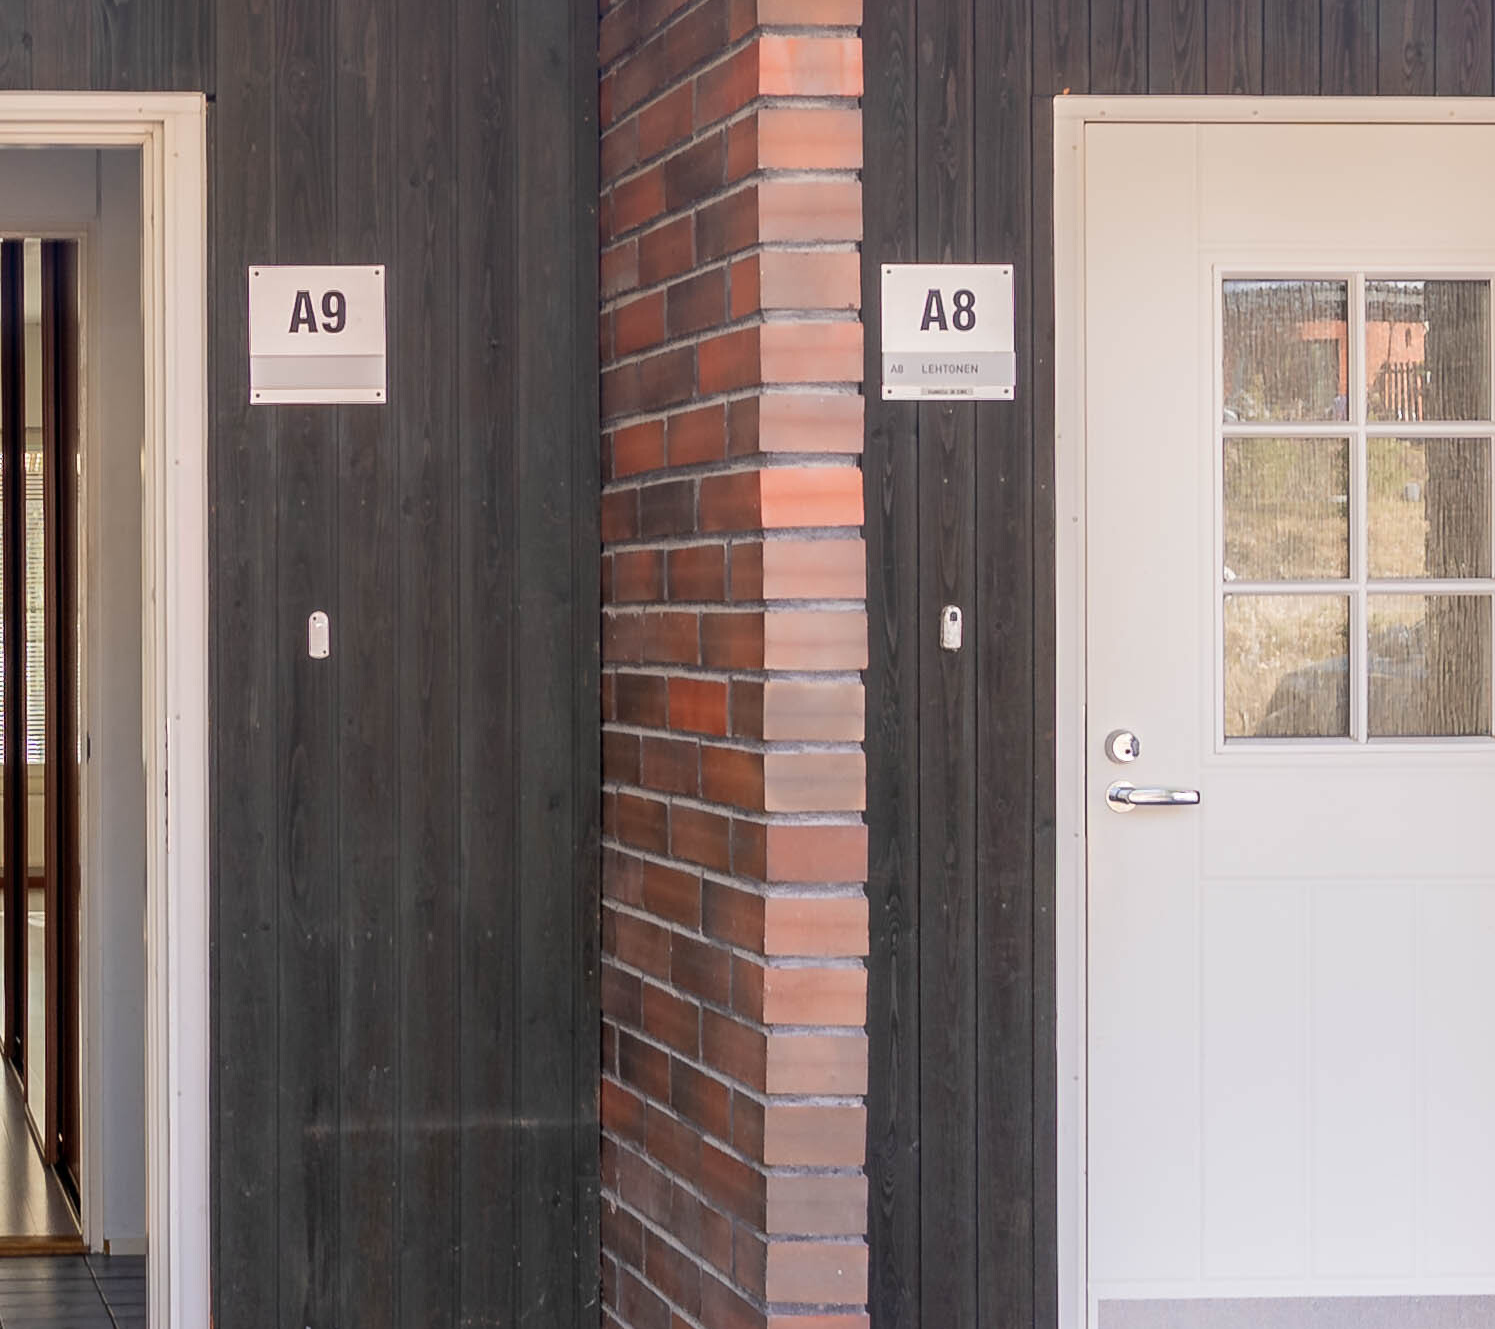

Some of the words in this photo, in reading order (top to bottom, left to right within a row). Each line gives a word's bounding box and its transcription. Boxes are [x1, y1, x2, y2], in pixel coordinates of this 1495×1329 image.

[288, 289, 347, 334] A9
[919, 288, 976, 332] A8
[921, 363, 979, 374] LEHTONEN
